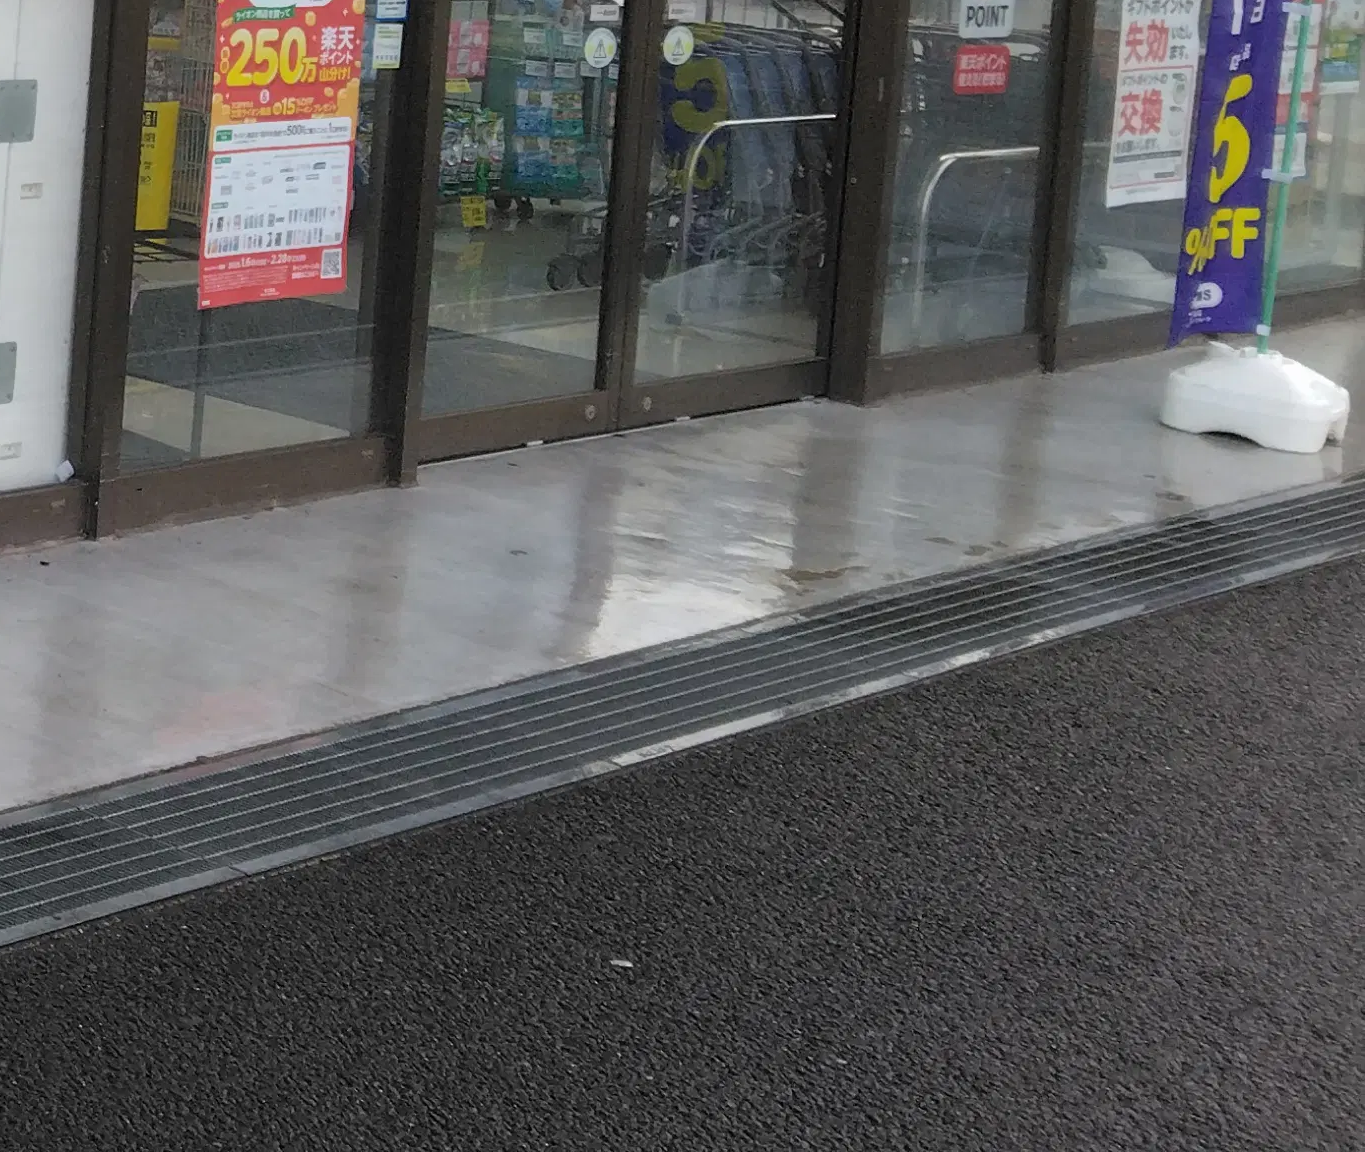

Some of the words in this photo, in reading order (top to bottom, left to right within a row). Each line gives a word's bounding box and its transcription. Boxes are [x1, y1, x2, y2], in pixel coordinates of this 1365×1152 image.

[966, 5, 1009, 28] POINT
[320, 26, 356, 51] 楽天
[1123, 19, 1170, 65] 失効
[319, 51, 354, 66] ポイント
[1118, 88, 1164, 137] 交換
